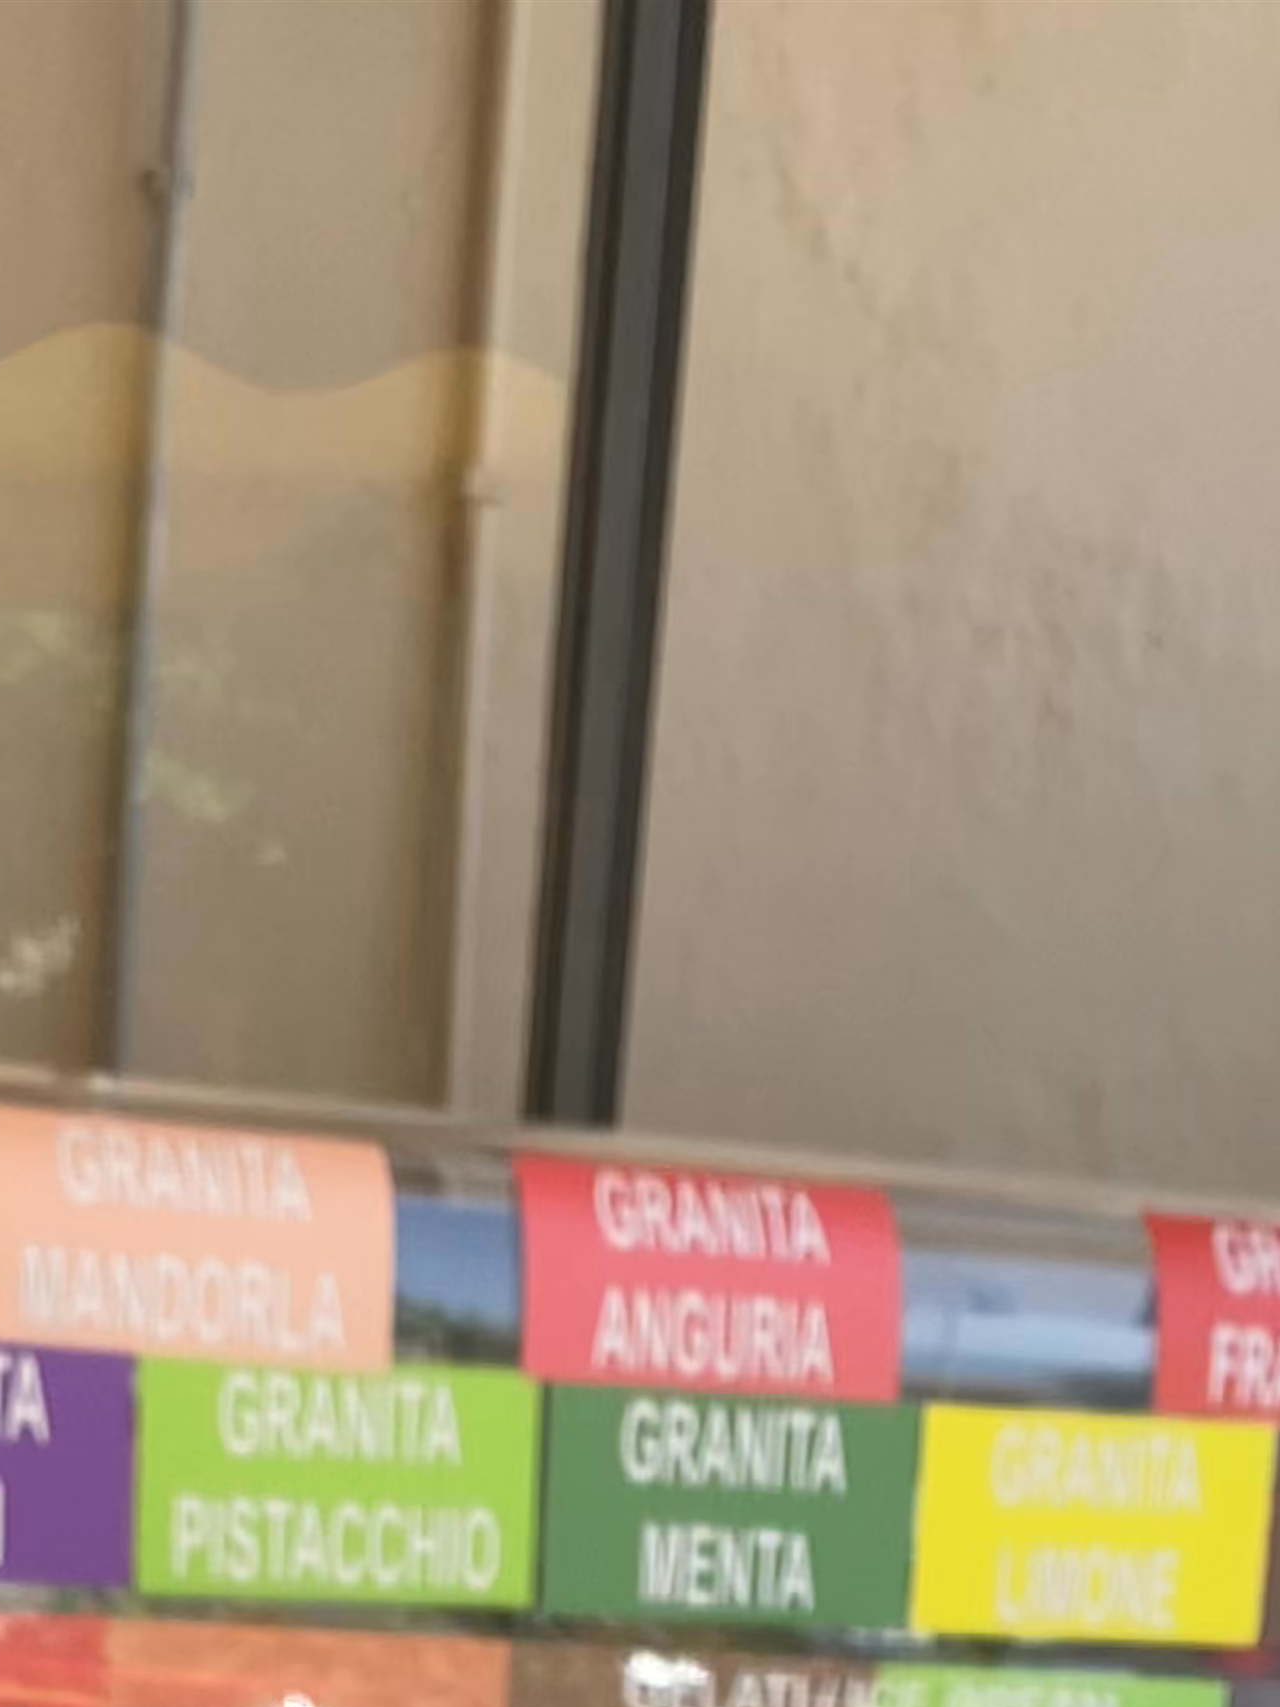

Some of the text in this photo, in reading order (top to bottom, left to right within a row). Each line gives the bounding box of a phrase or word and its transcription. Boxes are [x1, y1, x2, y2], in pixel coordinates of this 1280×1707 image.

[54, 1123, 312, 1223] GRANITA
[592, 1169, 830, 1266] GRANITA
[17, 1244, 347, 1353] MANDORLA
[592, 1286, 833, 1383] ANGURIA
[217, 1371, 463, 1467] GRANITA
[620, 1399, 846, 1494] GRANITA
[990, 1424, 1203, 1516] GRANITA
[171, 1492, 501, 1592] PISTACCHIO
[636, 1520, 815, 1613] MENTA
[992, 1545, 1181, 1630] LIMONE
